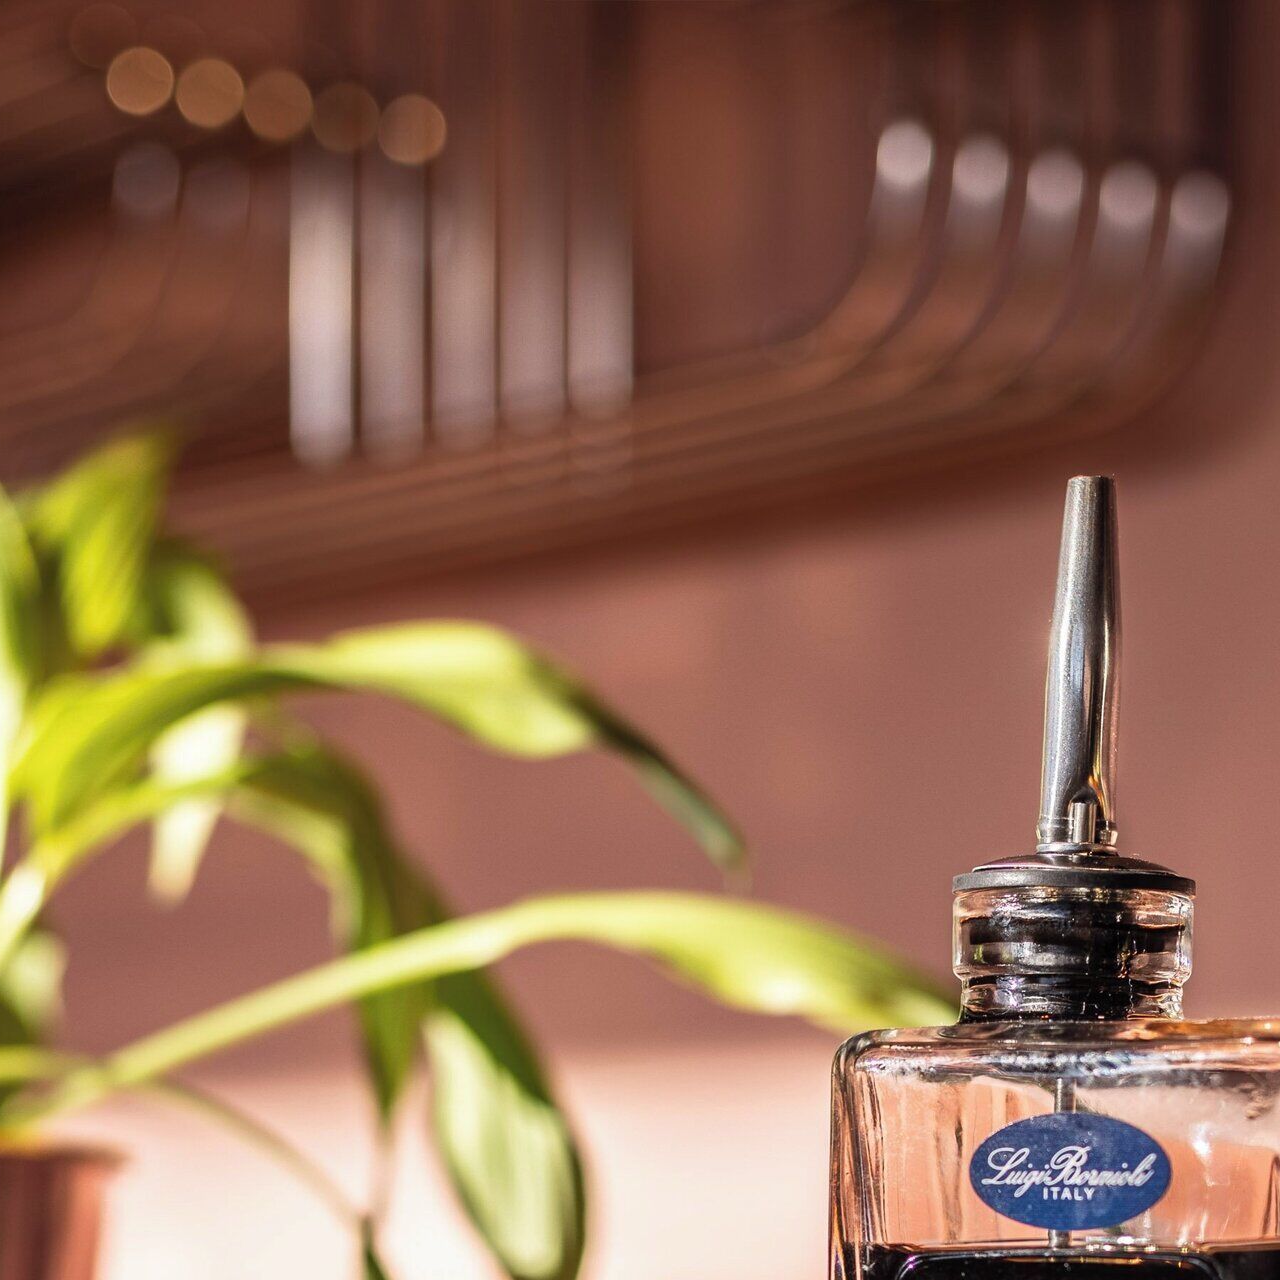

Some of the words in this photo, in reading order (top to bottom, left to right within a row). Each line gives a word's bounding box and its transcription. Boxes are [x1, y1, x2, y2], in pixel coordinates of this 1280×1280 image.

[981, 1146, 1053, 1198] Luigi
[1049, 1145, 1157, 1188] Bormioli
[1043, 1187, 1095, 1201] ITALY
